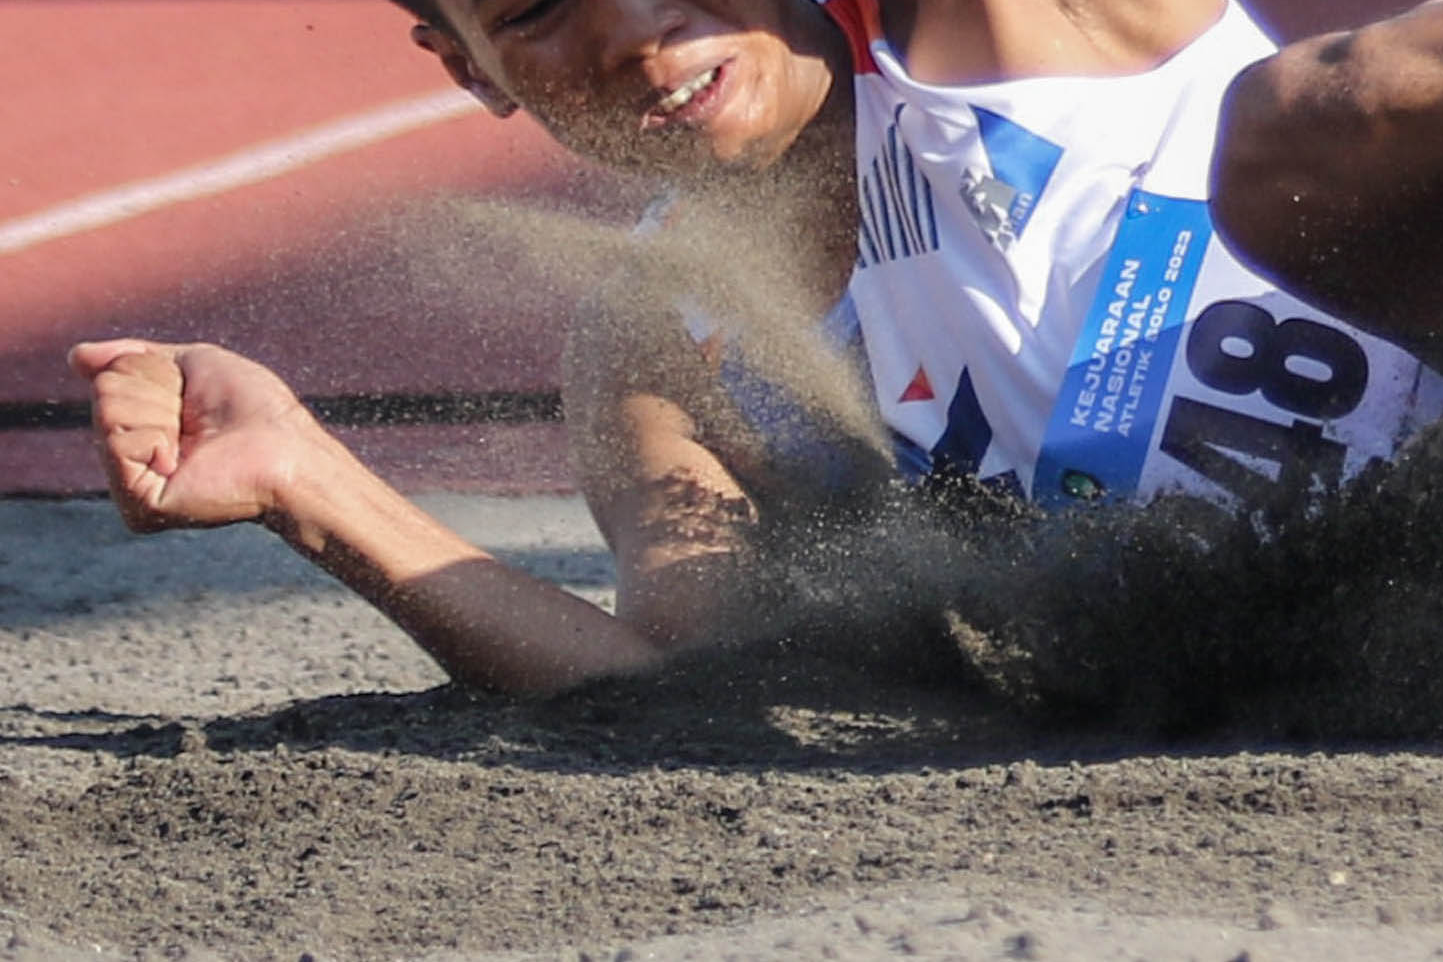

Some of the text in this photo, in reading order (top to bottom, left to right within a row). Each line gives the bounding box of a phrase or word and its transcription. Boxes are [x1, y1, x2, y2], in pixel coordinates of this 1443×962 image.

[1069, 258, 1141, 427] KEJUARAAN
[1093, 293, 1152, 433] NASIONAL
[1116, 229, 1192, 438] ATLETIK SOLO 2023
[1159, 299, 1369, 506] 48
